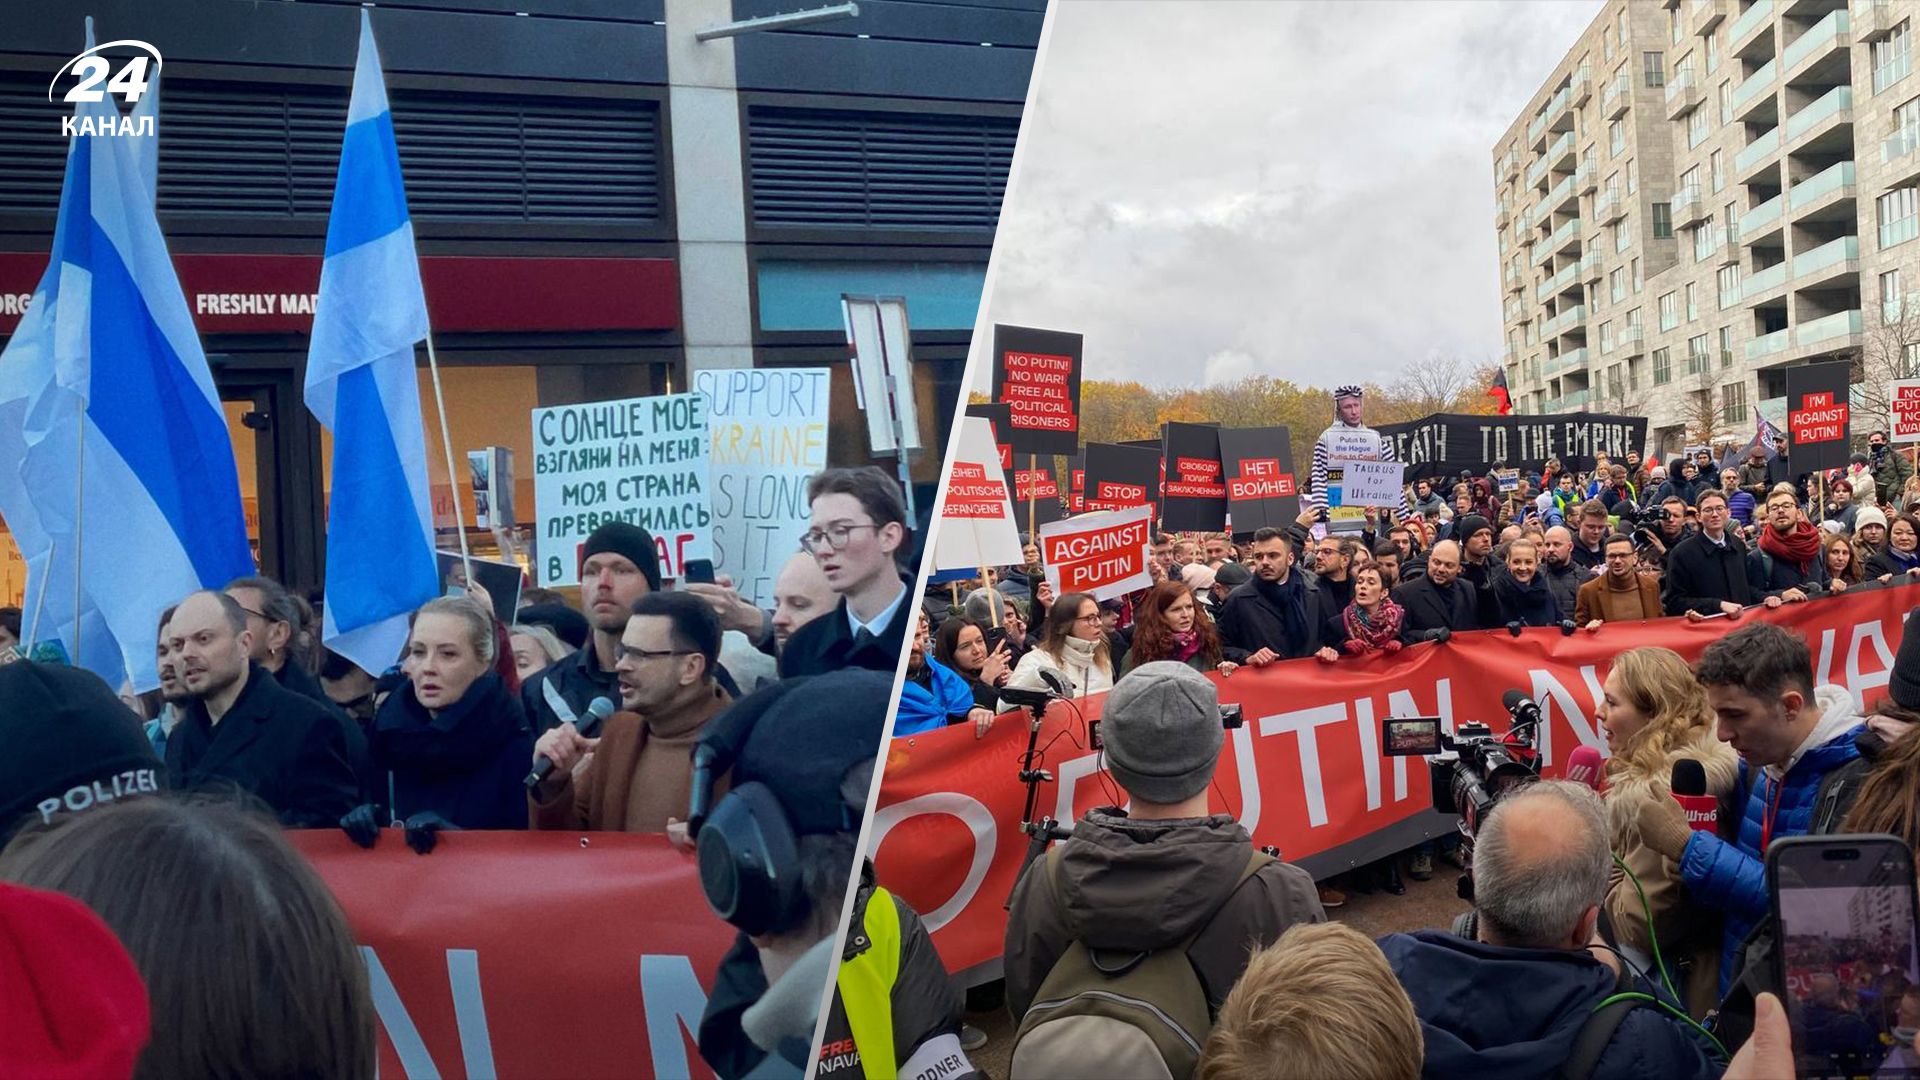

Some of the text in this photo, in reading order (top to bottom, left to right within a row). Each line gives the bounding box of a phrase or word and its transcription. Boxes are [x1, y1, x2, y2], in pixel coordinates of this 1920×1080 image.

[197, 294, 277, 315] FRESHLY
[1008, 355, 1069, 371] NO PUTIN!
[1011, 371, 1064, 385] NO WAR!
[698, 371, 826, 417] SUPPORT
[1010, 385, 1064, 399] FREE ALL
[1809, 395, 1826, 408] I'M
[539, 402, 644, 446] СОЛНЦЕ
[1010, 414, 1071, 428] RISONERS
[1794, 409, 1844, 426] AGAINST
[1801, 425, 1839, 440] PUTIN!
[711, 422, 824, 467] KRAINE
[1349, 445, 1371, 453] Hague
[1479, 425, 1507, 463] TO
[1518, 424, 1557, 461] THE
[1565, 422, 1634, 458] EMPIRE
[536, 446, 611, 474] ВЗГЛЯНИ
[618, 443, 642, 468] НА
[1180, 461, 1217, 472] СВОБОДУ
[1245, 461, 1275, 476] НЕТ
[1354, 463, 1396, 475] TAURUS
[562, 471, 701, 507] МОЯ СТРАНА
[1104, 485, 1141, 499] STOP
[1232, 478, 1292, 497] ВОЙНЕ!
[1351, 488, 1394, 500] Ukraine
[711, 474, 733, 519] S
[1054, 524, 1143, 561] AGAINST
[548, 556, 563, 581] В
[1073, 555, 1131, 586] PUTIN
[36, 769, 158, 826] POLIZEI
[1686, 810, 1717, 822] Штаб
